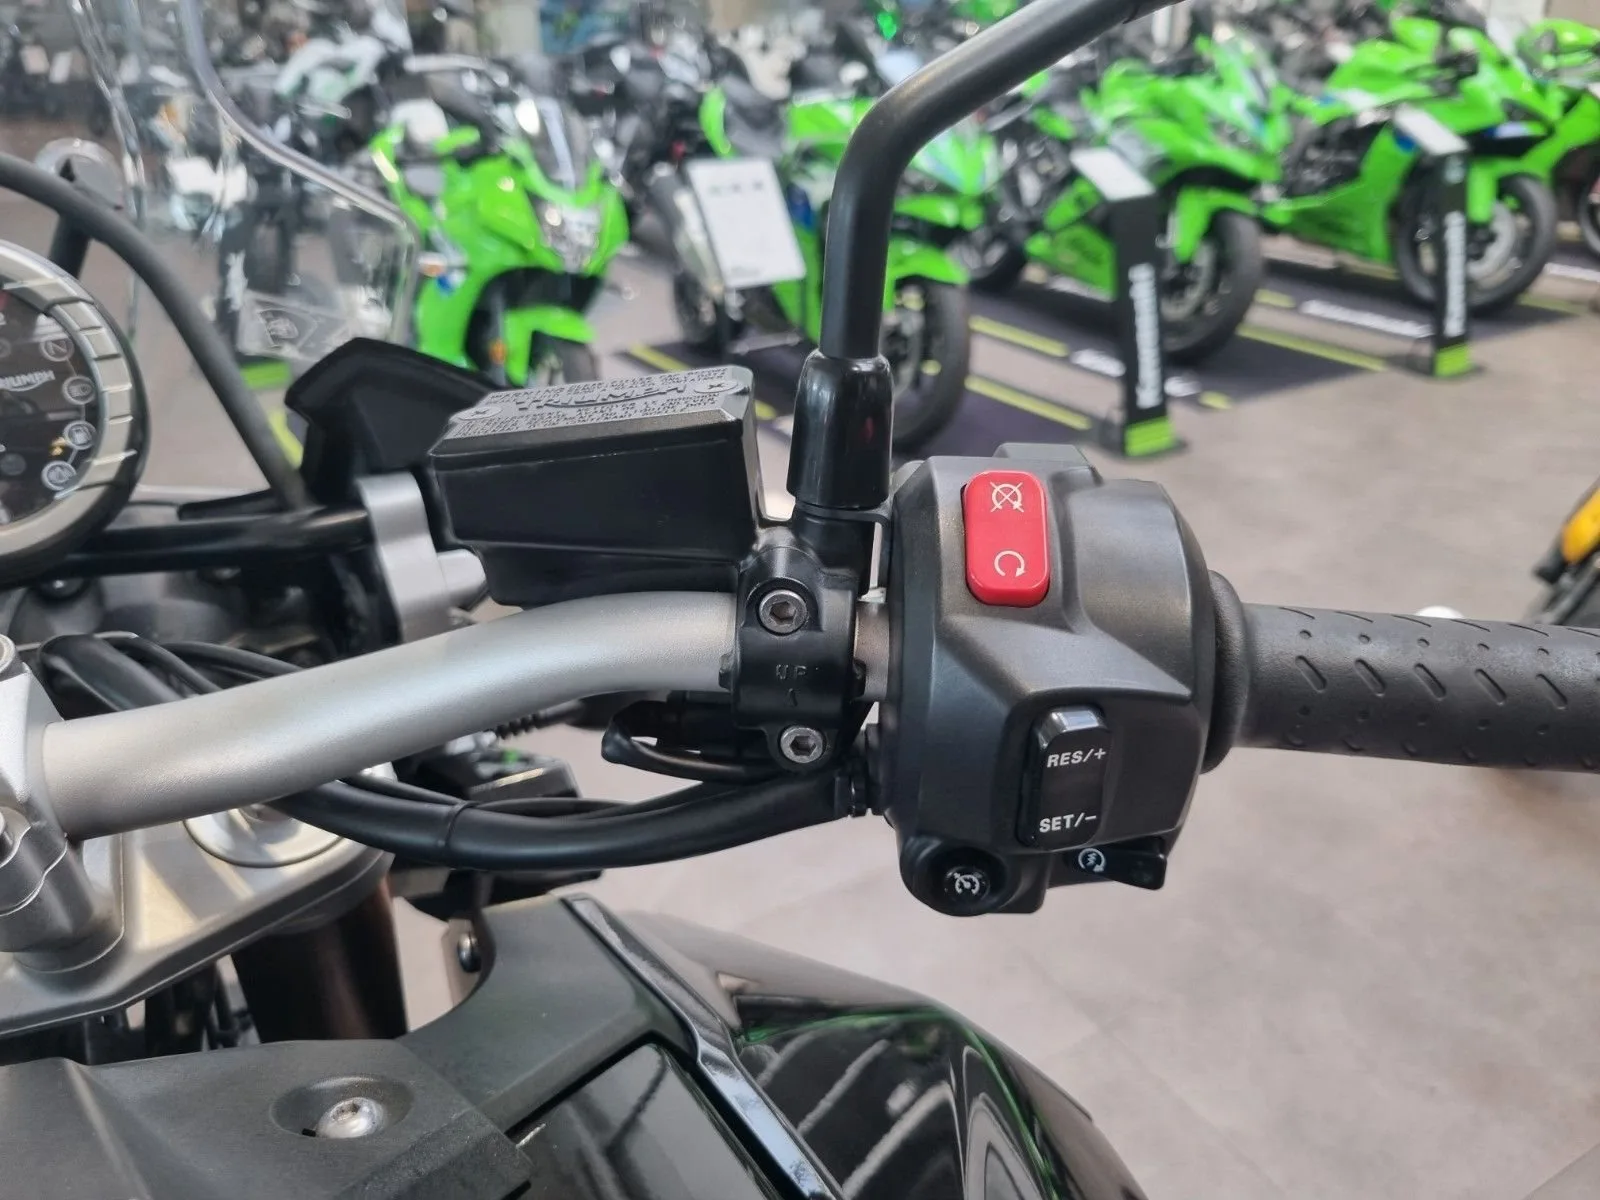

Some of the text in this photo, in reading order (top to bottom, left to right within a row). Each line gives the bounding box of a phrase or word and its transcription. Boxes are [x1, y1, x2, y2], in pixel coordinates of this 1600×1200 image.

[515, 384, 688, 412] TRIUMPH
[776, 664, 807, 680] UP
[1046, 748, 1107, 768] RES/+
[1039, 812, 1097, 833] SET/-
